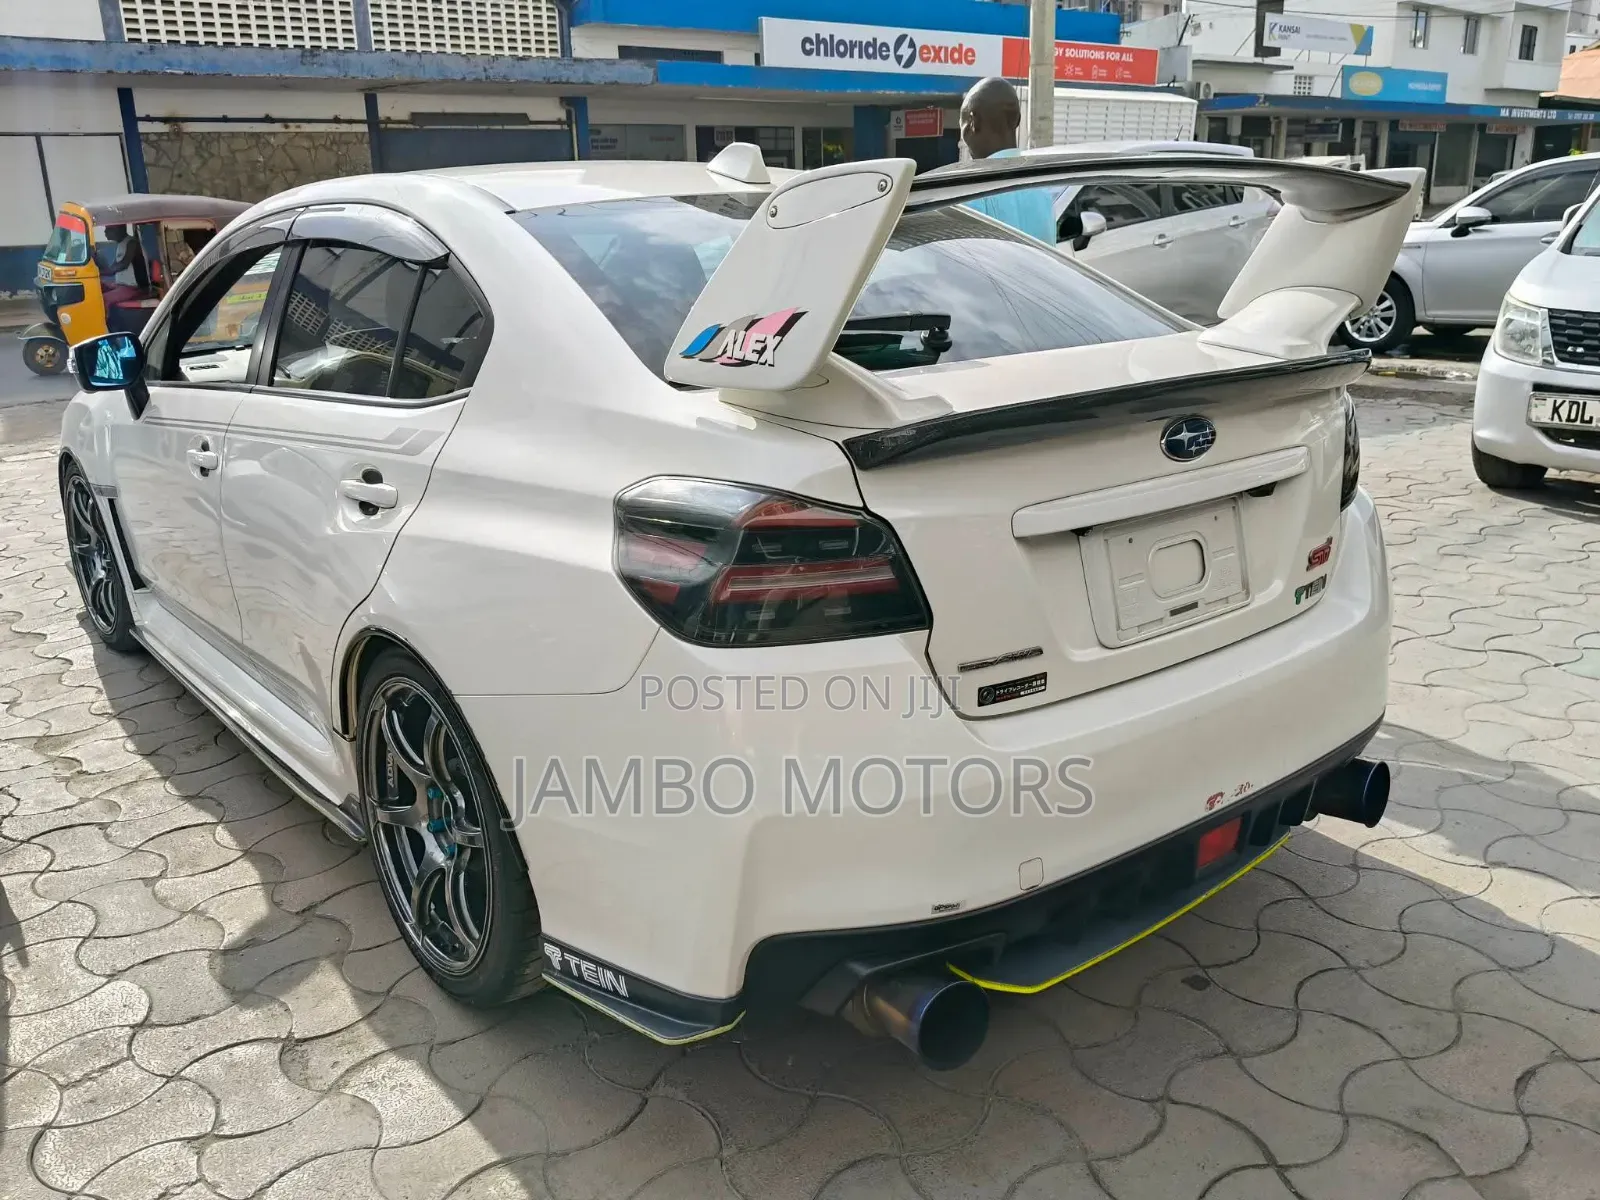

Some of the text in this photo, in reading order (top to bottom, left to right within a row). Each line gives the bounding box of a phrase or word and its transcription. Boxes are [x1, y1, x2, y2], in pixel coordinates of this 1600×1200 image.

[1279, 25, 1300, 34] KANSAI
[801, 33, 976, 66] chloride exide
[1065, 48, 1105, 60] SOLUTIONS
[1106, 52, 1120, 61] FOR
[1121, 53, 1133, 62] ALL
[1511, 108, 1546, 119] INVESTMENTS
[1547, 109, 1557, 120] LTD
[717, 329, 783, 367] ALEX
[1551, 399, 1594, 425] KDL
[564, 952, 629, 998] TEIN
